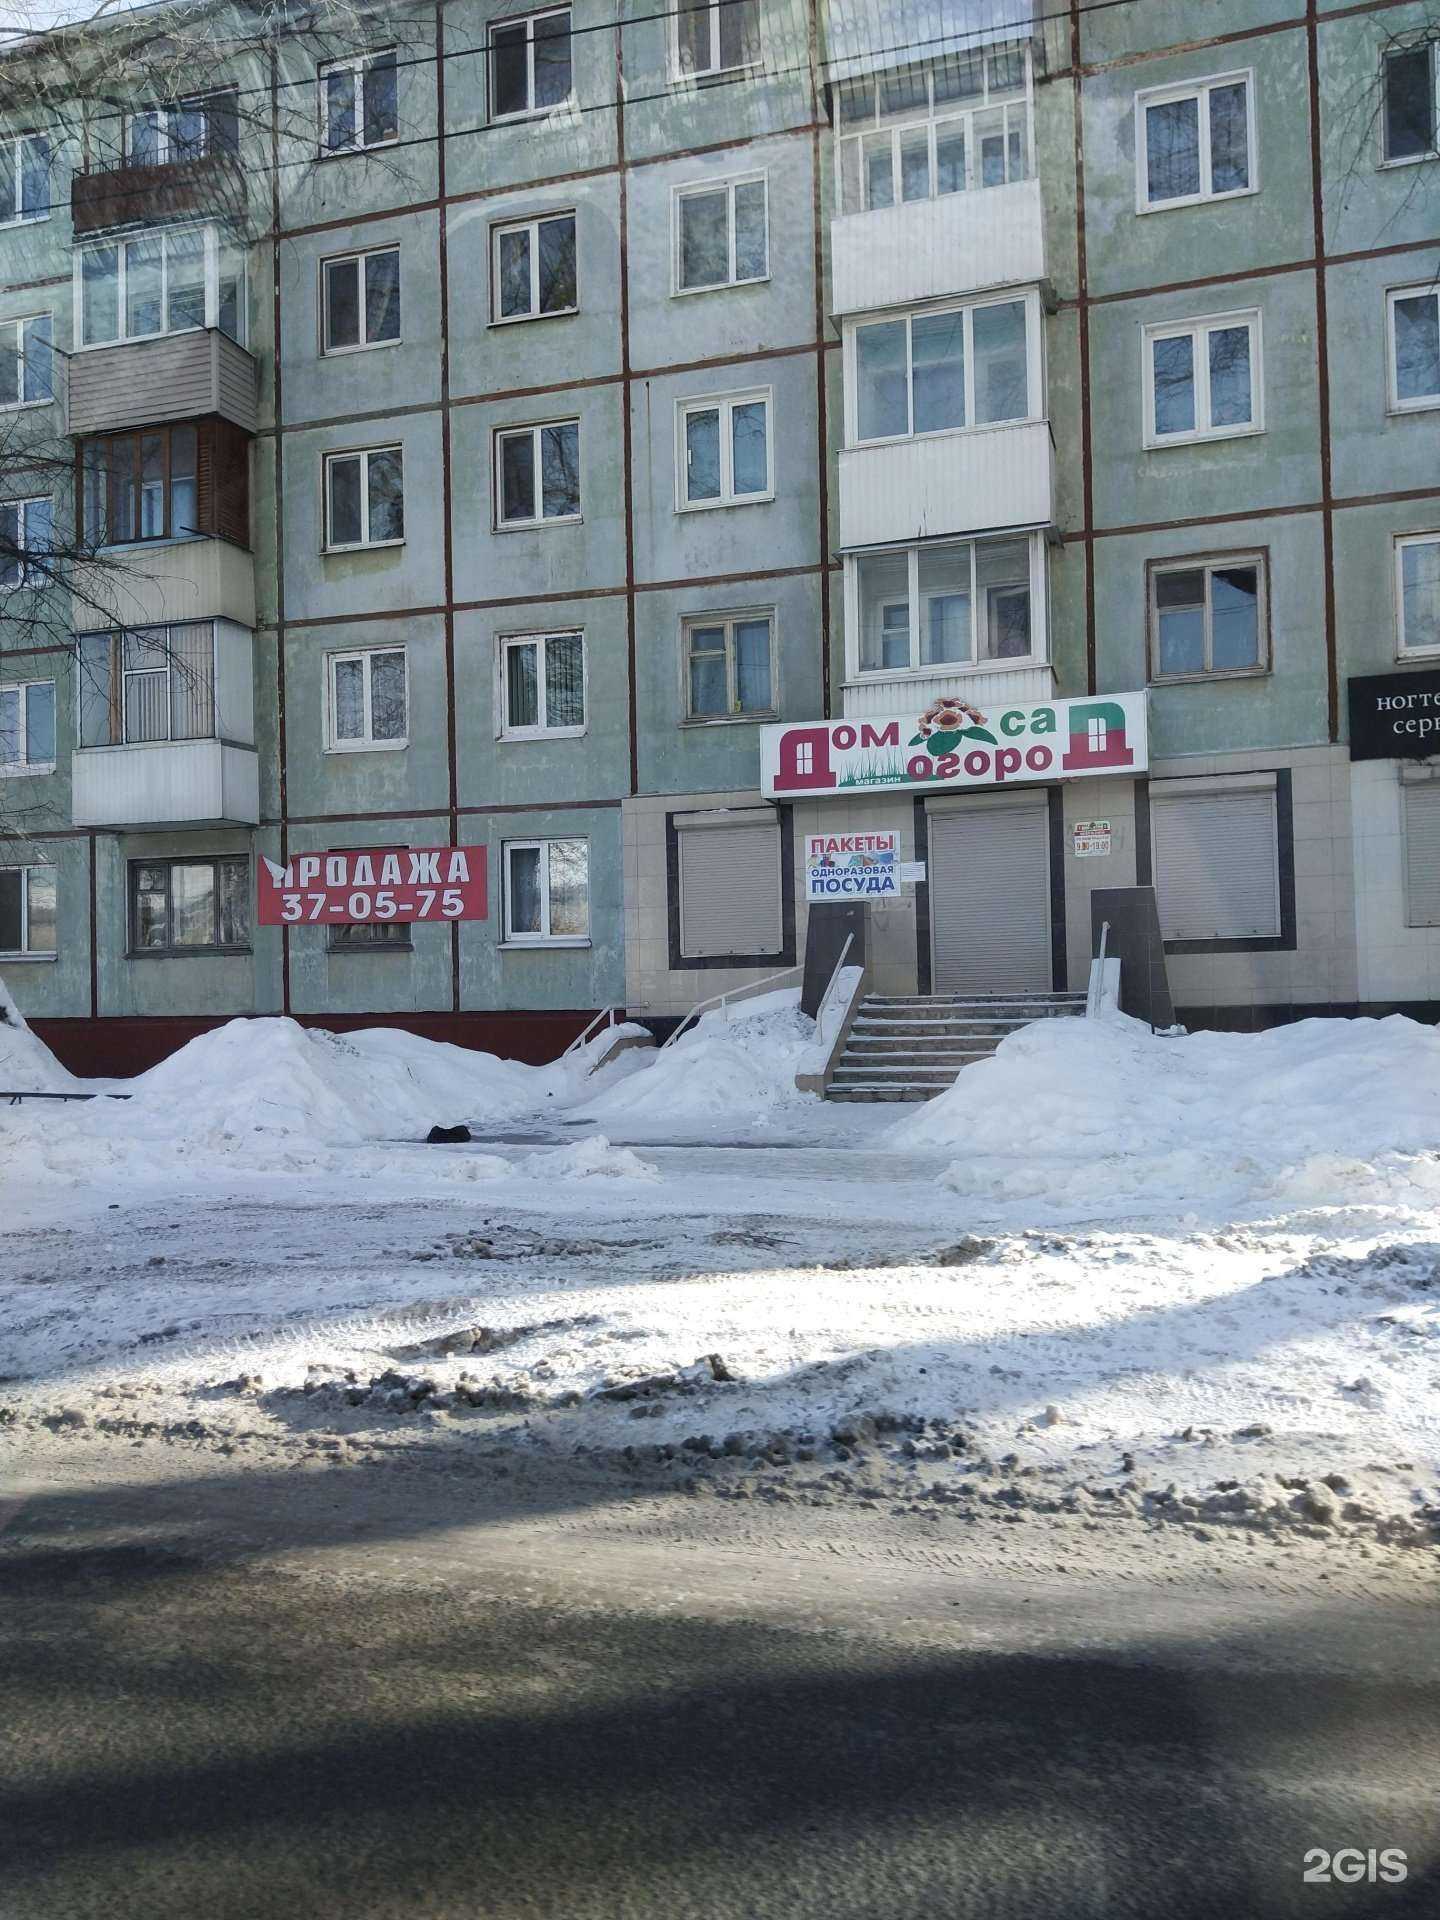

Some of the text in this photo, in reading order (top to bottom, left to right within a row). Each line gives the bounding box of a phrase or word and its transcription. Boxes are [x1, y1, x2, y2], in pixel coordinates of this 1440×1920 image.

[774, 721, 900, 791] Дом
[855, 776, 901, 786] магазин
[811, 835, 894, 853] ПАКЕТЫ
[811, 866, 894, 877] ОДНОРАЗОВАЯ
[811, 876, 895, 893] ПОСУДА
[281, 889, 465, 921] 37-05-75
